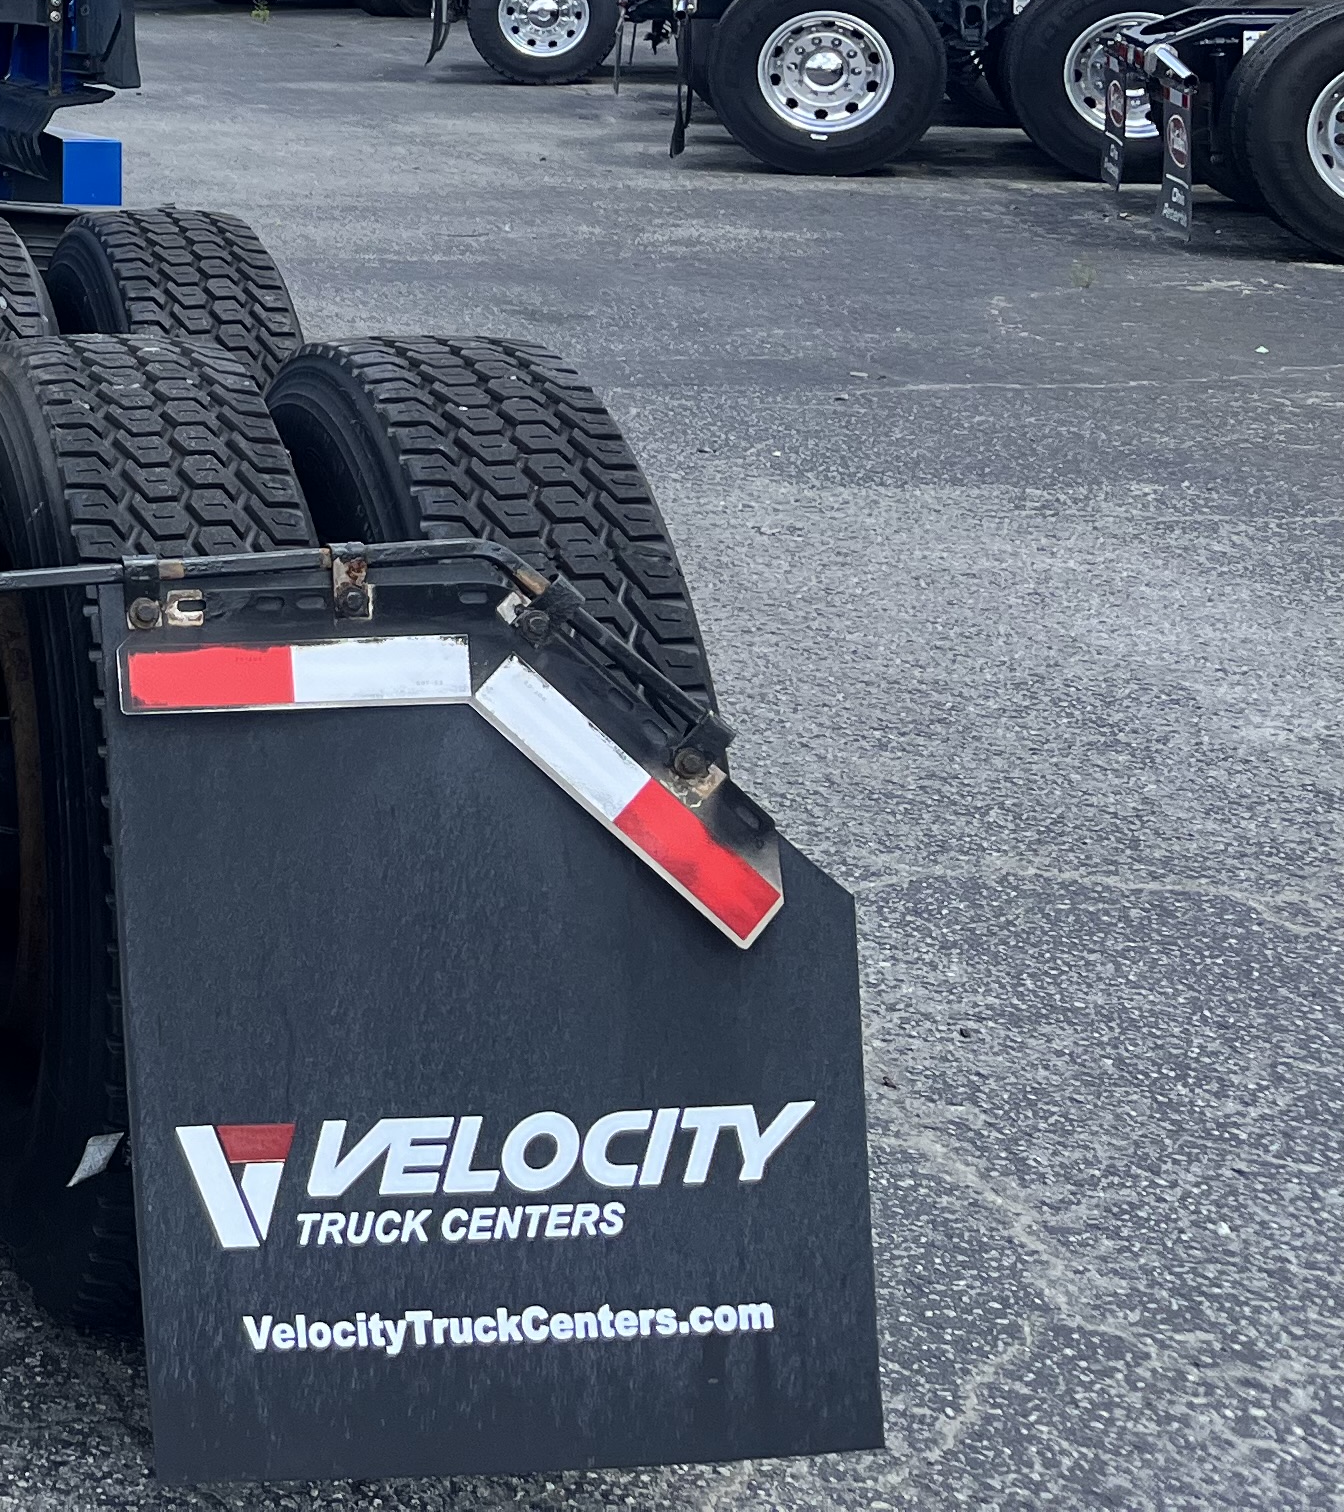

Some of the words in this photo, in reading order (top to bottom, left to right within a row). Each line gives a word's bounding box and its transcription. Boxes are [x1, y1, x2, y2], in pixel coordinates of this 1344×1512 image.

[307, 1101, 816, 1199] VELOCITY
[297, 1209, 432, 1245] TRUCK
[442, 1202, 625, 1243] CENTERS
[243, 1303, 774, 1357] VelocityTruckCenters.com
